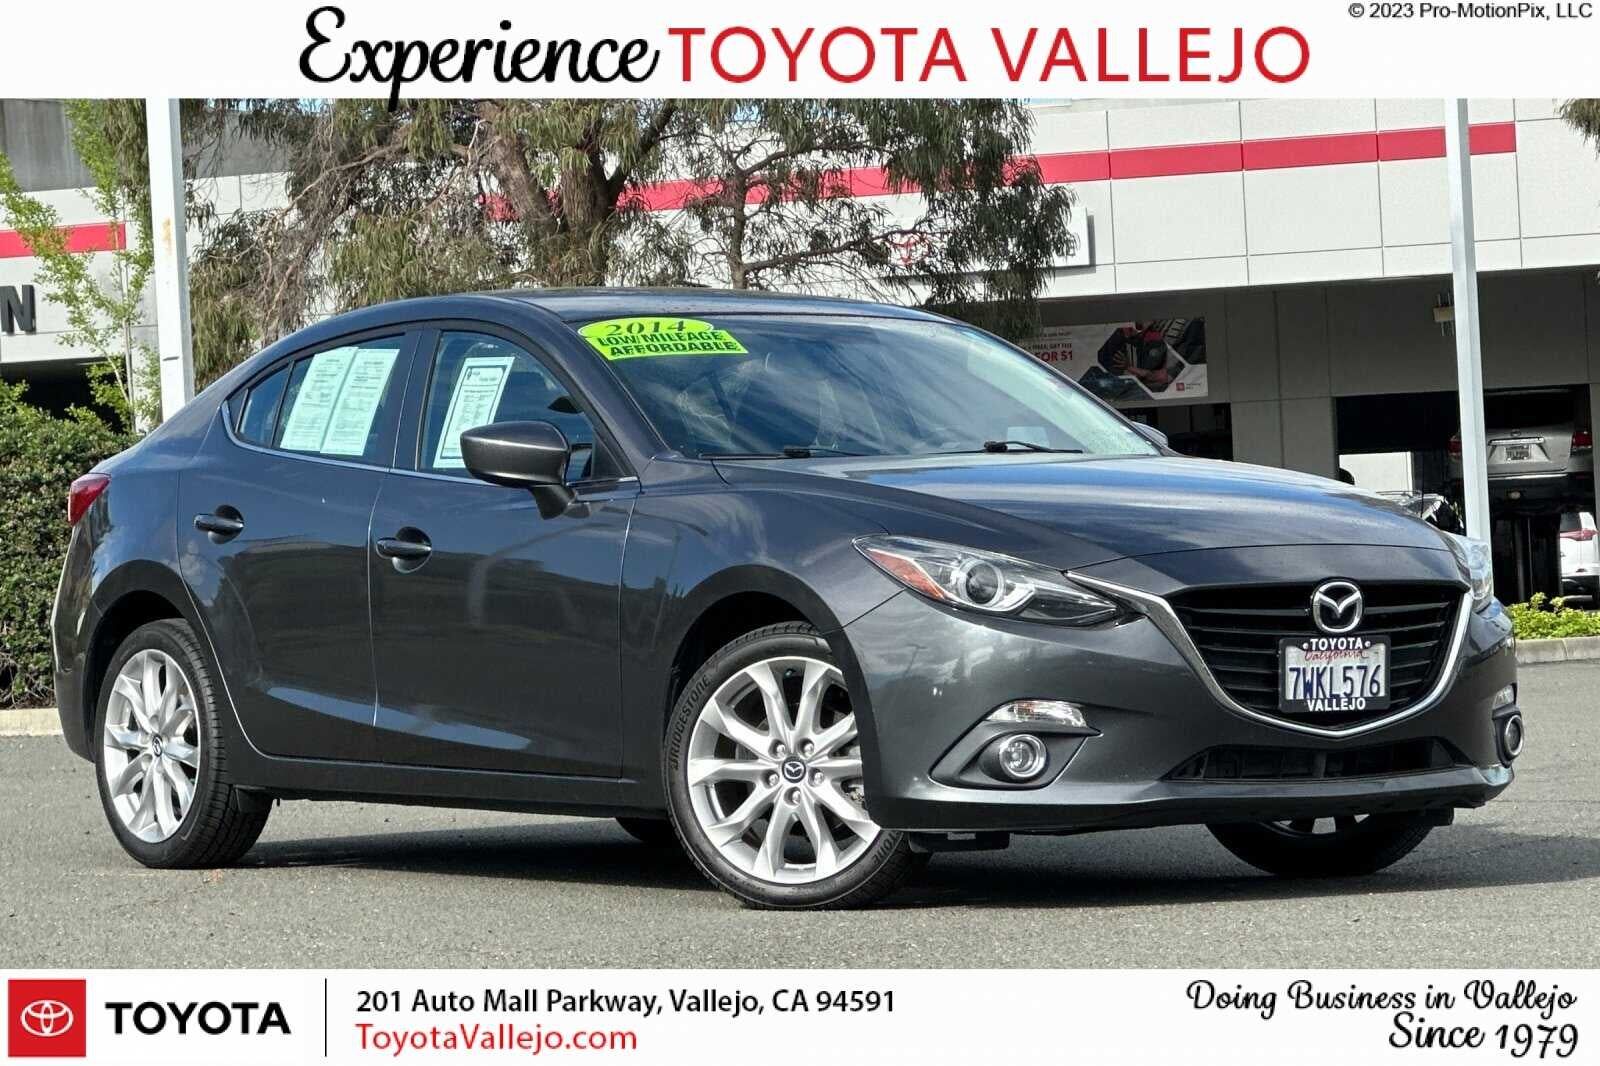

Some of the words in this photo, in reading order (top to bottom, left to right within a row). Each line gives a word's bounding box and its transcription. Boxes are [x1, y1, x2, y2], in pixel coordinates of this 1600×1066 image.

[605, 321, 686, 336] 2014
[597, 335, 638, 347] LOW
[641, 330, 723, 343] MILEAGE
[609, 340, 737, 356] AFFORDABLE
[1310, 637, 1363, 650] TOYOTA
[1289, 664, 1382, 699] 7WKL576
[1307, 697, 1366, 711] VALLEJO
[668, 674, 711, 770] BRIDGESTONE
